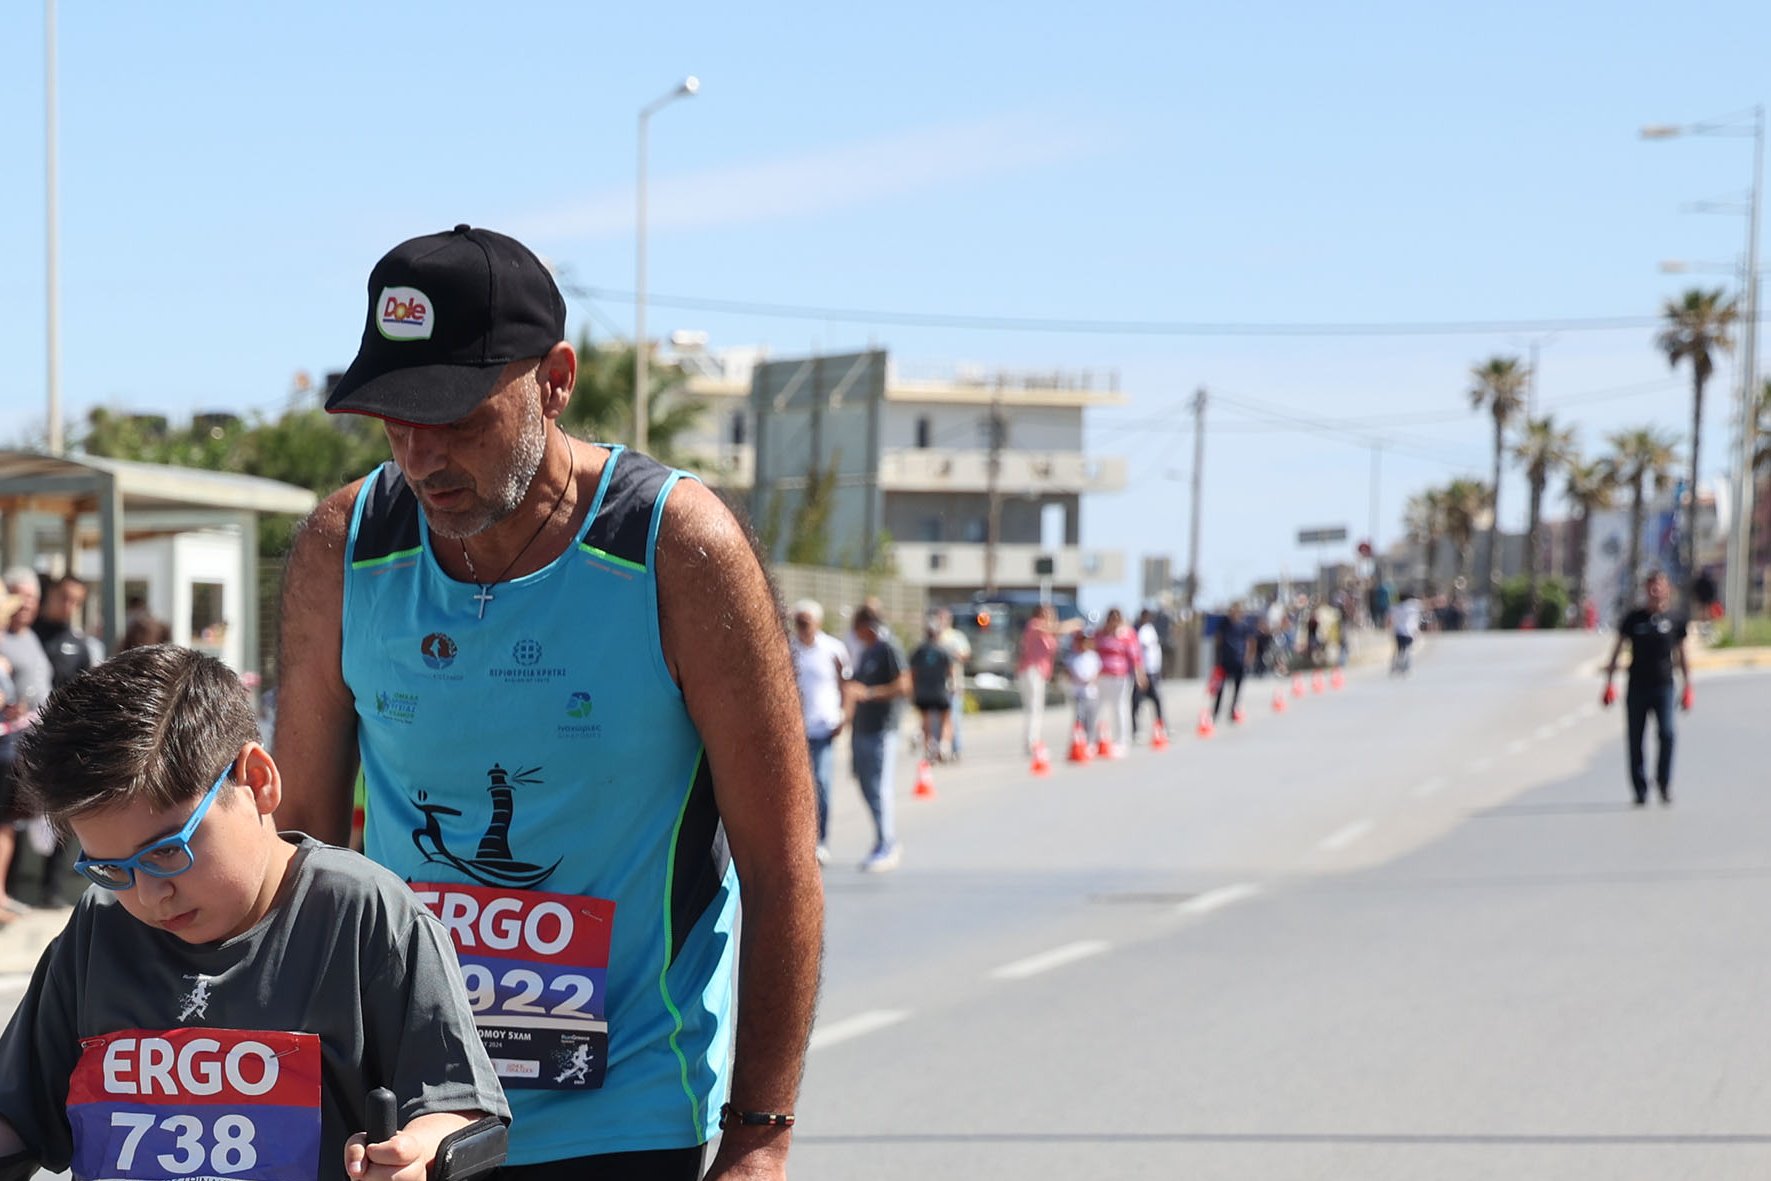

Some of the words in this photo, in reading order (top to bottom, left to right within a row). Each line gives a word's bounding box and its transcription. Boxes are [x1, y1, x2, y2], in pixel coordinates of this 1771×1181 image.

[384, 296, 427, 320] Dole
[463, 963, 595, 1020] 922
[102, 1037, 279, 1096] ERGO
[110, 1111, 257, 1175] 738
